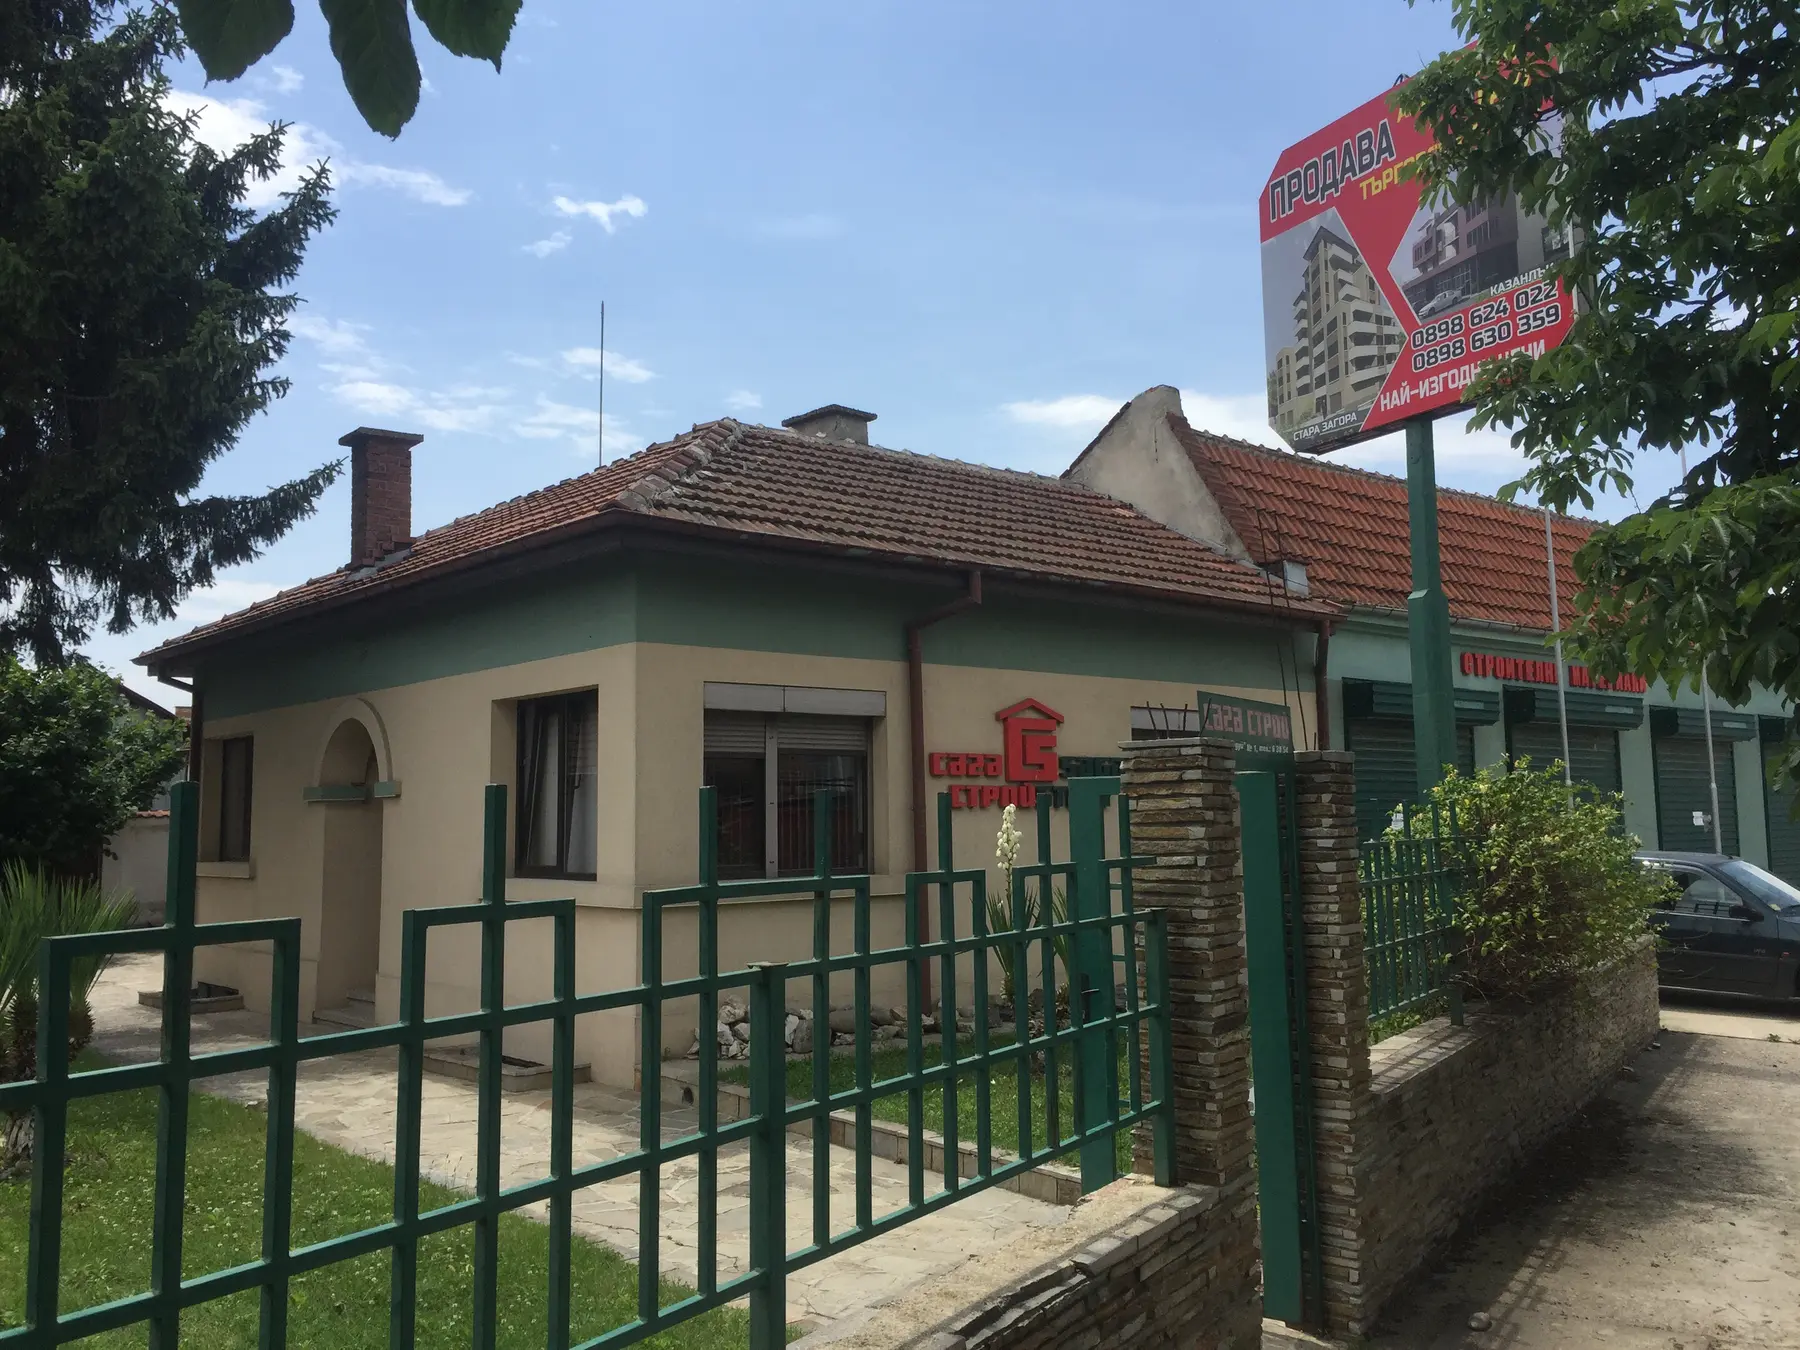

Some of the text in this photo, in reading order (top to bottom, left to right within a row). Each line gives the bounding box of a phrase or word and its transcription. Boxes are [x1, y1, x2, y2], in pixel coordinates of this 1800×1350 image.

[1269, 118, 1397, 223] ПРОДАВА
[1411, 280, 1559, 350] 0898 624 022
[1412, 302, 1562, 373] 0898 630 359
[1380, 357, 1490, 412] НАЙ-ИЗГОДН
[1293, 412, 1358, 441] СТАРА ЗАГОРА
